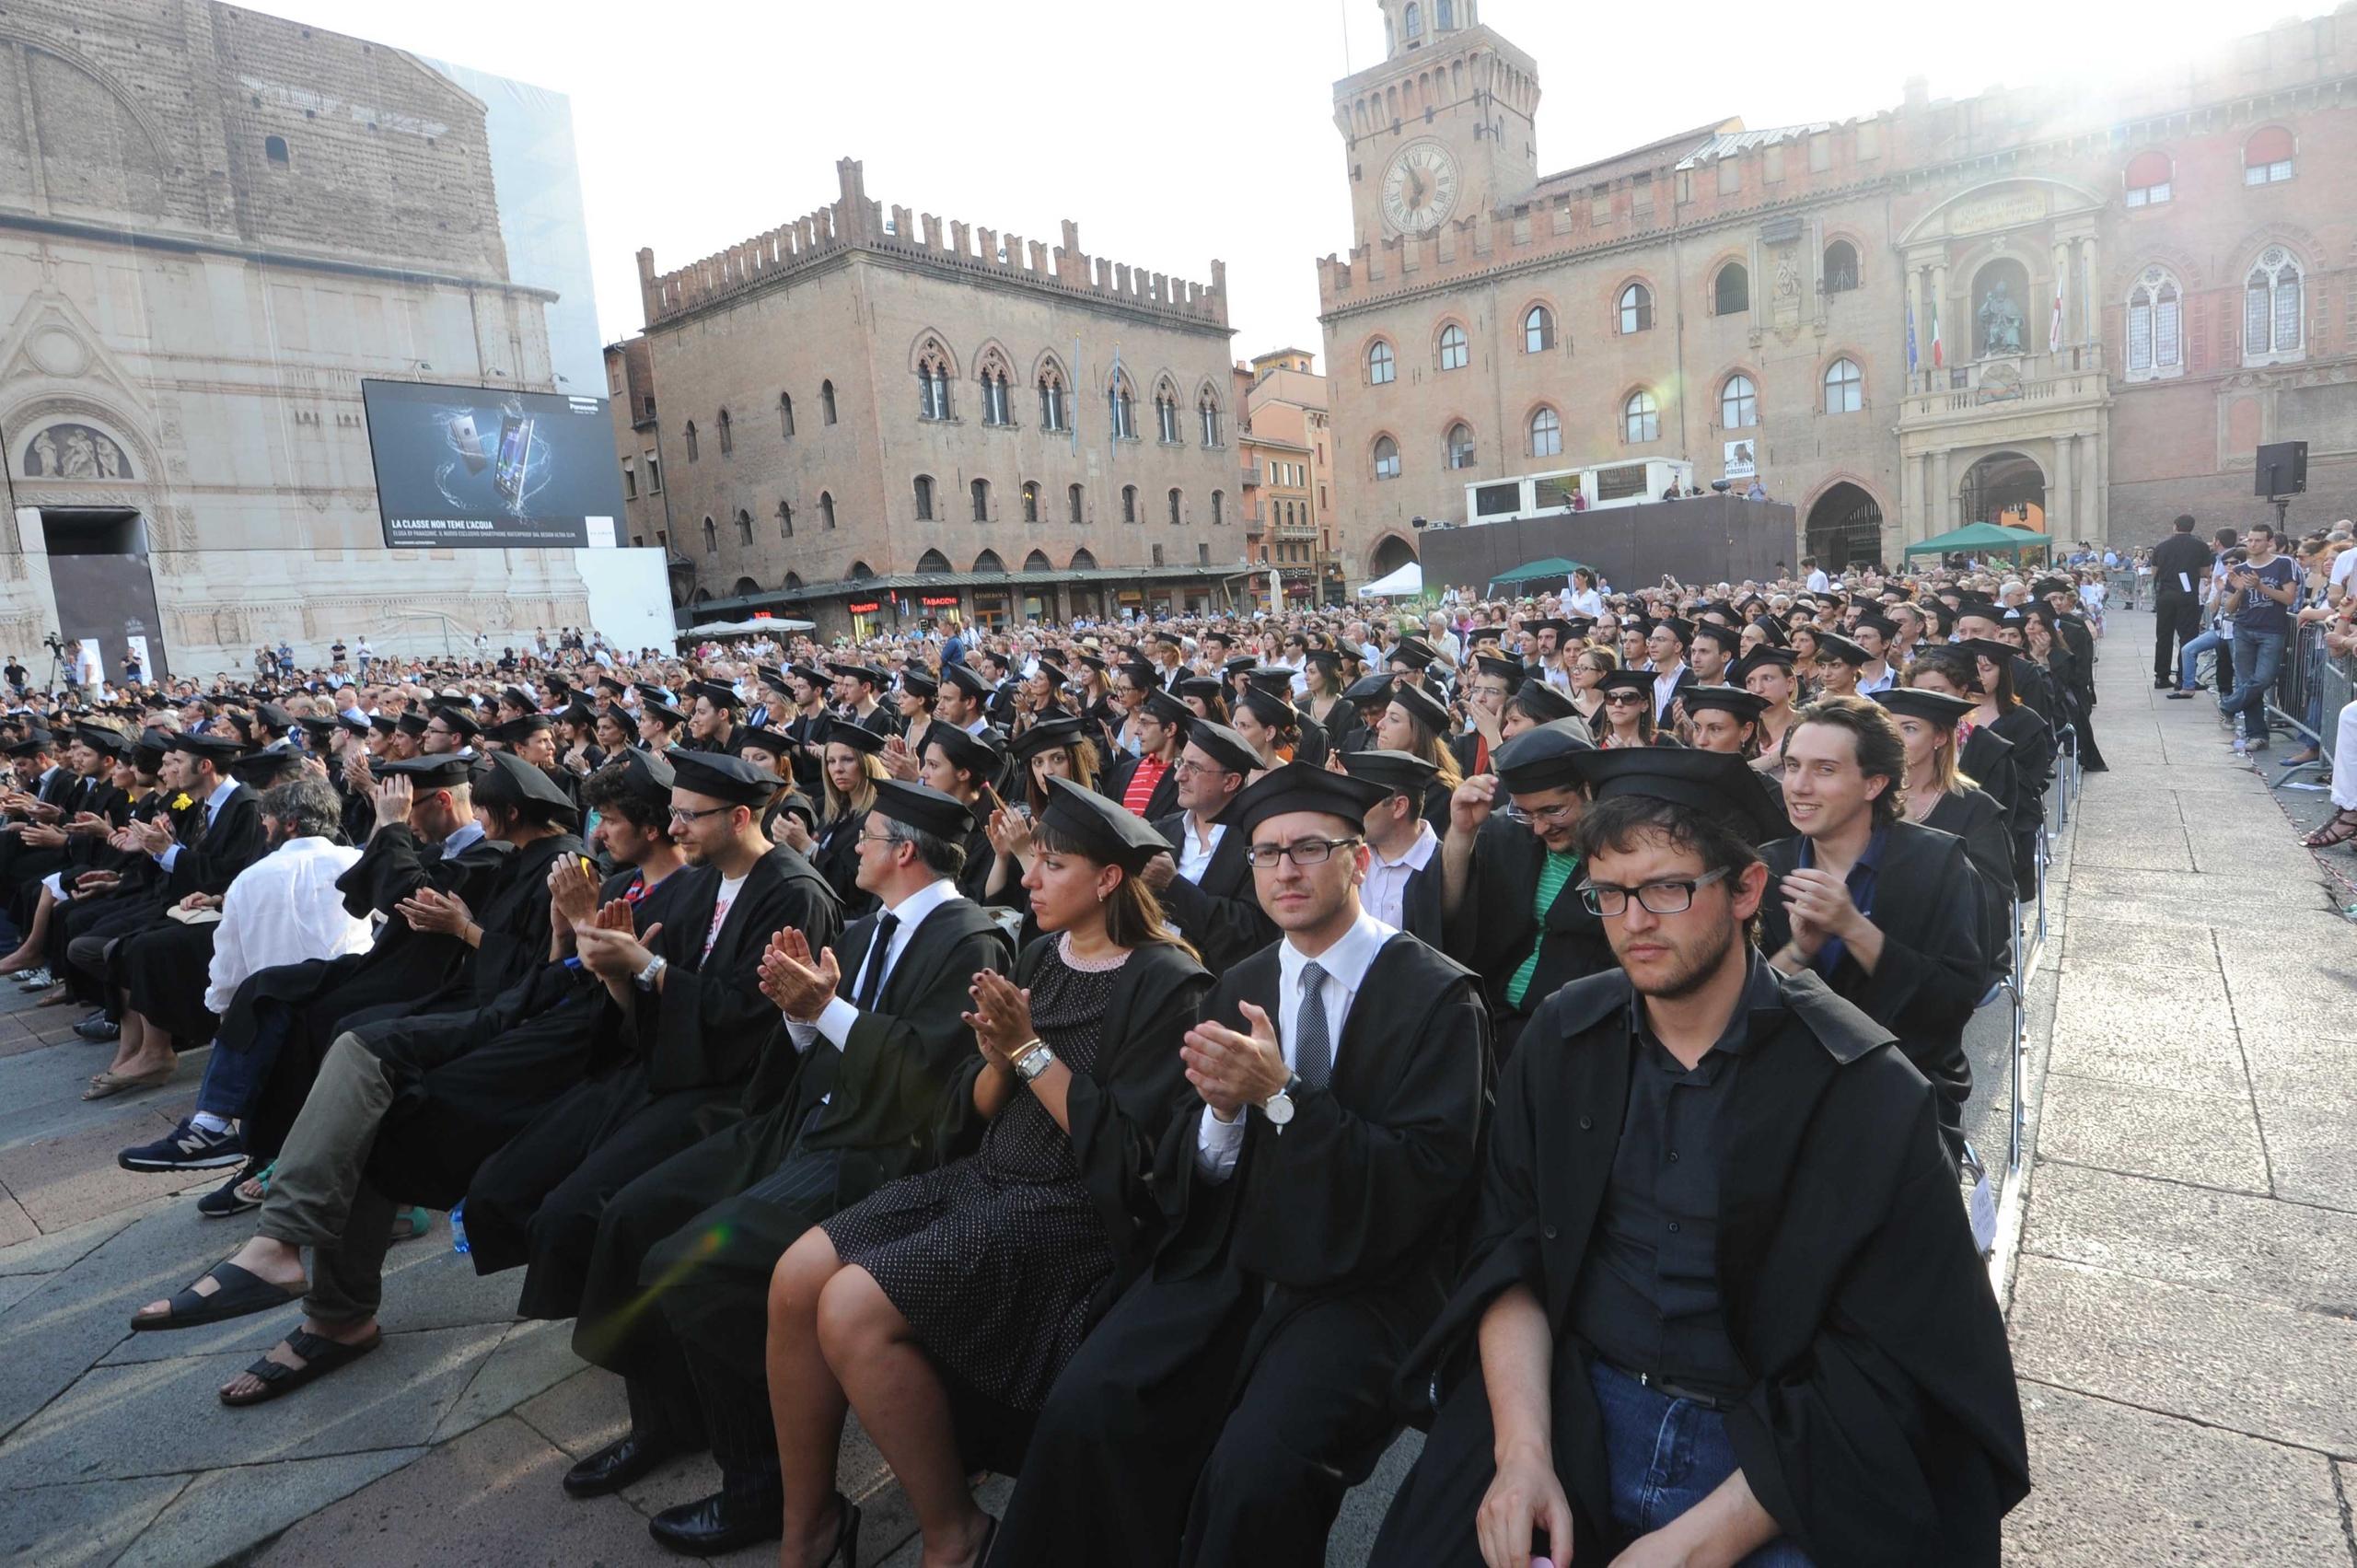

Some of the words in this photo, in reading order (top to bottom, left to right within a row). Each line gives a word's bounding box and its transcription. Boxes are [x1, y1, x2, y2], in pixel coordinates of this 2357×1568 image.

[391, 518, 401, 528] LA
[402, 519, 430, 528] CLASSE
[431, 519, 447, 528] NON
[447, 520, 465, 528] TEME
[466, 520, 493, 529] L'ACQUA
